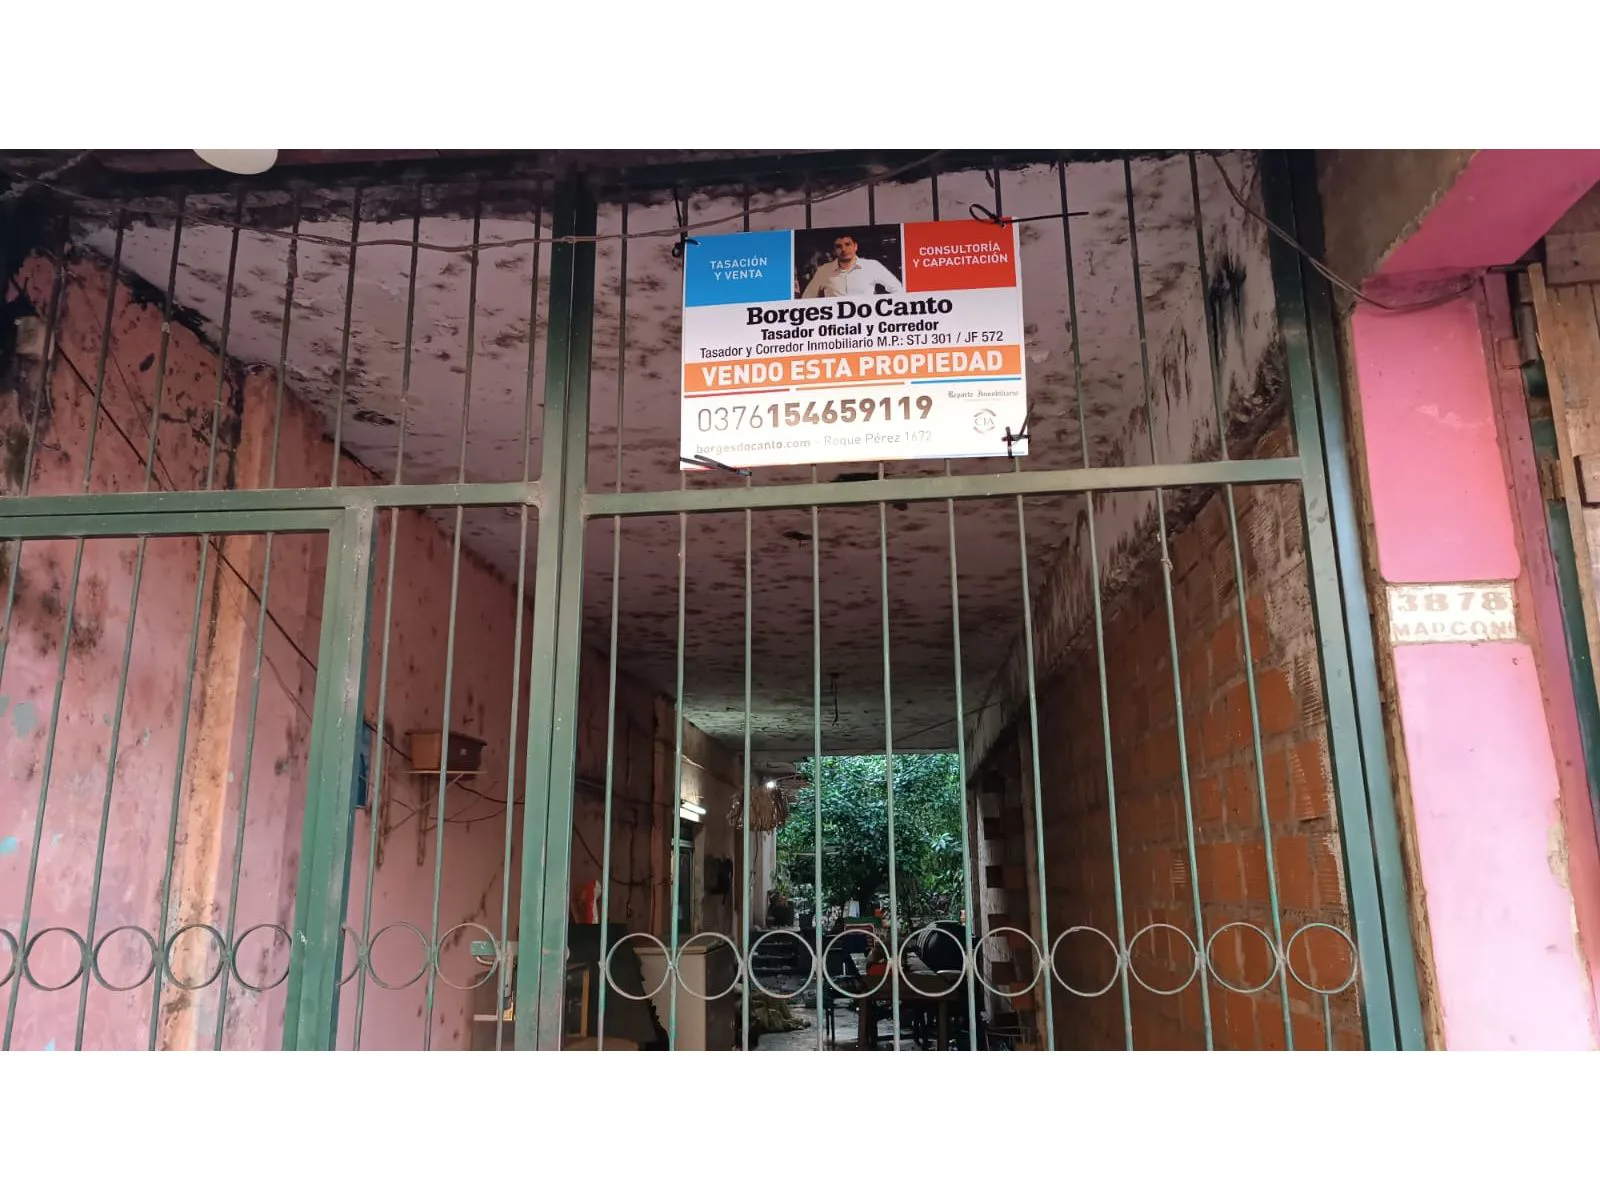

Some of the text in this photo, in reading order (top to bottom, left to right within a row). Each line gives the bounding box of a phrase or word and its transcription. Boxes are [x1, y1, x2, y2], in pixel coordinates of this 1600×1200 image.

[920, 241, 1000, 256] CONSULTORÍA
[710, 255, 768, 270] TASACIÓN
[912, 252, 1008, 268] Y CAPACITACIÓN
[714, 269, 763, 281] Y VENTA
[746, 297, 953, 326] Borges Do Canto
[761, 320, 939, 340] Tasador Oficial y Corredor
[700, 330, 1004, 358] Tasador y Corredor Inmobiliario M.P.: STJ 301 / JF 572
[702, 350, 1003, 386] VENDO ESTA PROPIEDAD
[824, 434, 862, 447] Roque
[865, 432, 900, 445] Pérez
[1398, 592, 1508, 612] 3878
